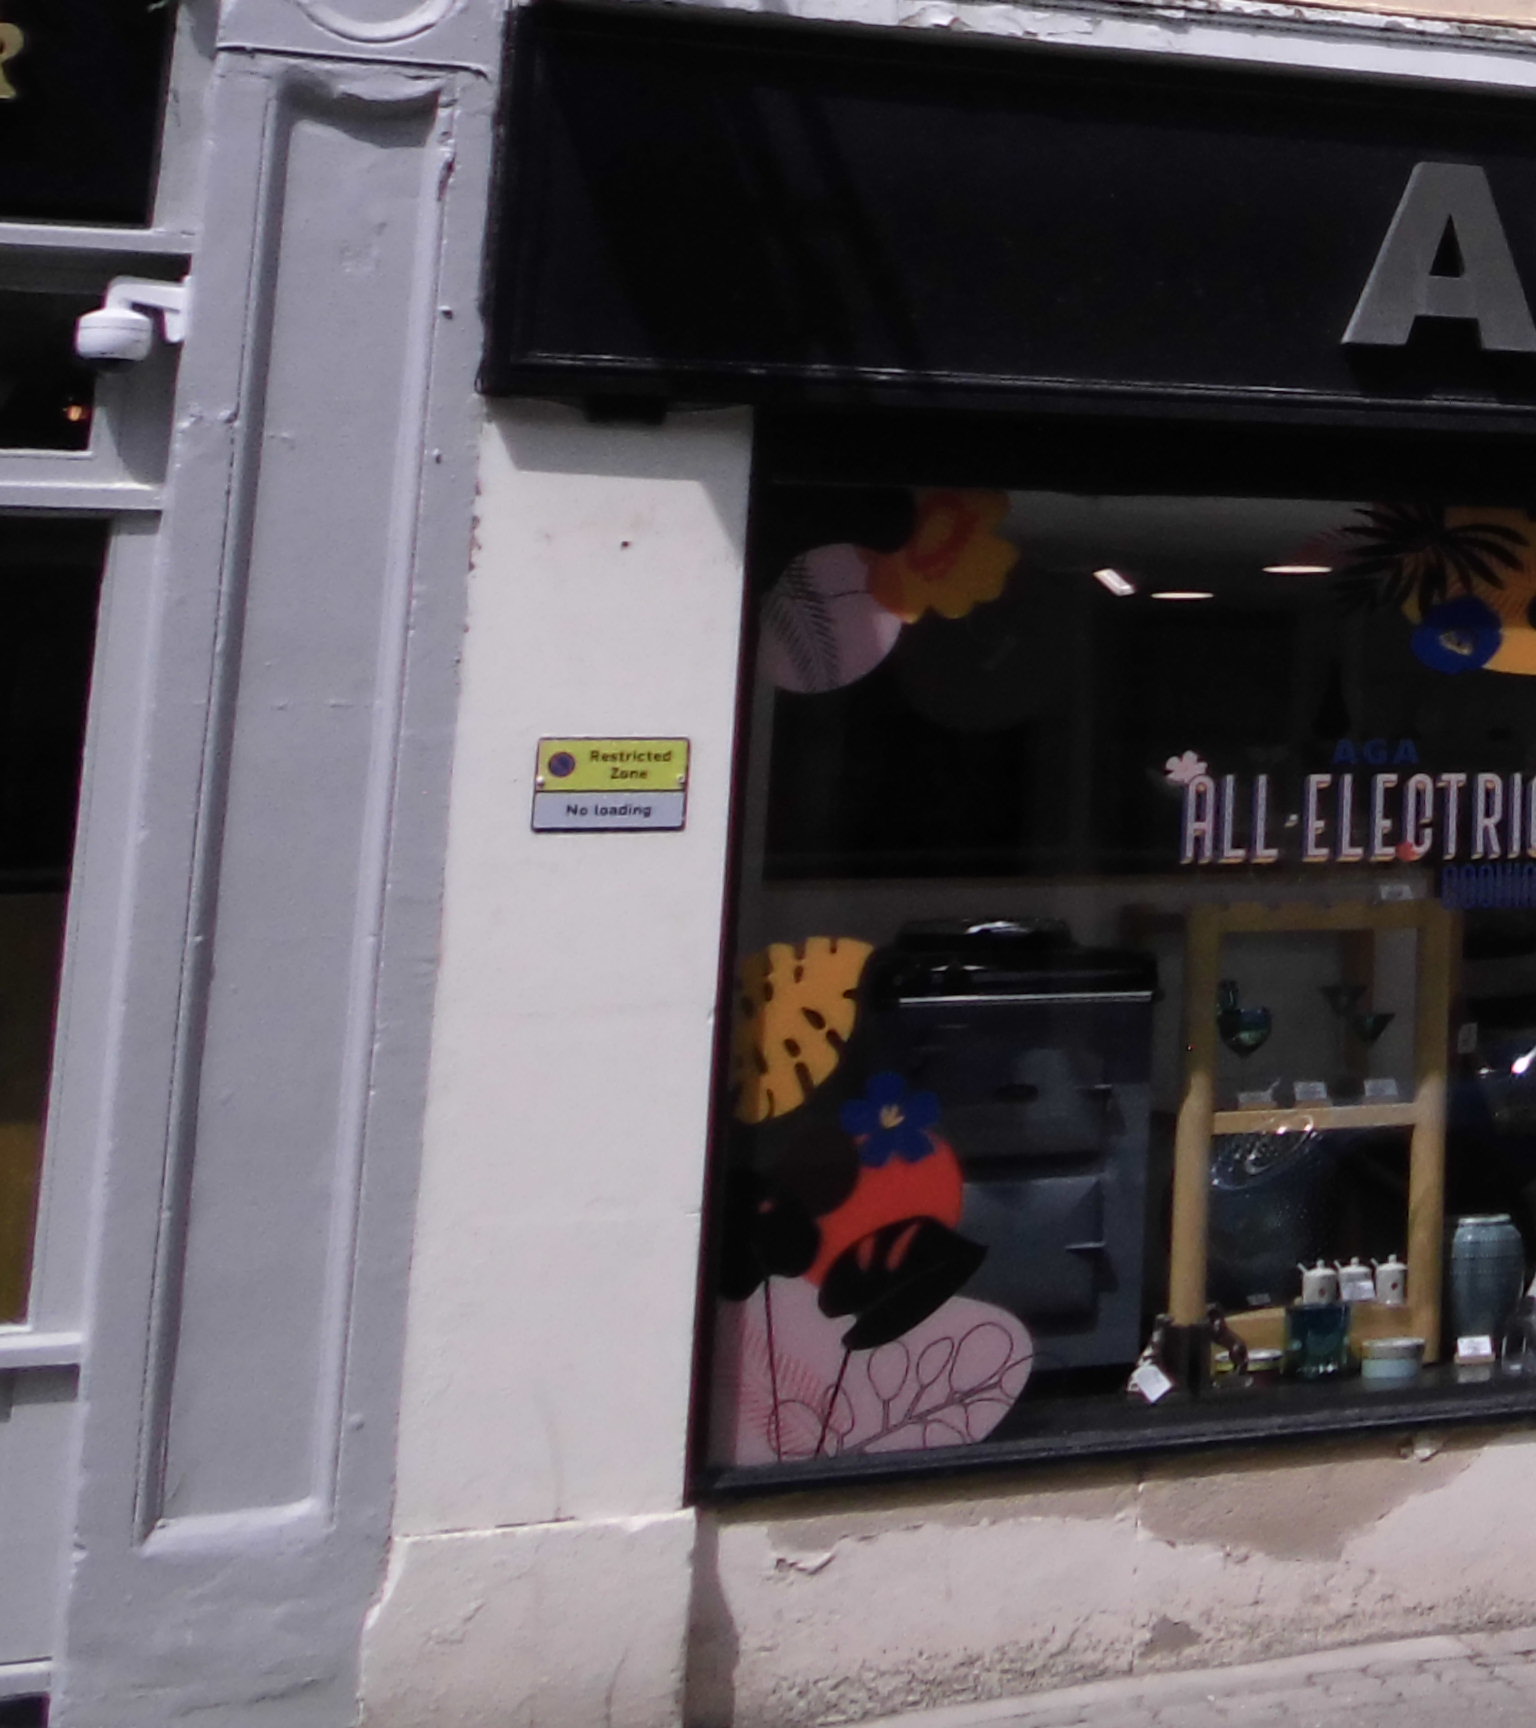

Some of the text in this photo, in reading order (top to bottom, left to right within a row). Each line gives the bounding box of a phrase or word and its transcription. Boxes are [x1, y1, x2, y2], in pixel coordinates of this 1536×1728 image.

[589, 749, 672, 763] Restricted
[1333, 737, 1420, 765] AGA
[610, 767, 648, 780] Zone
[566, 803, 652, 818] No loading
